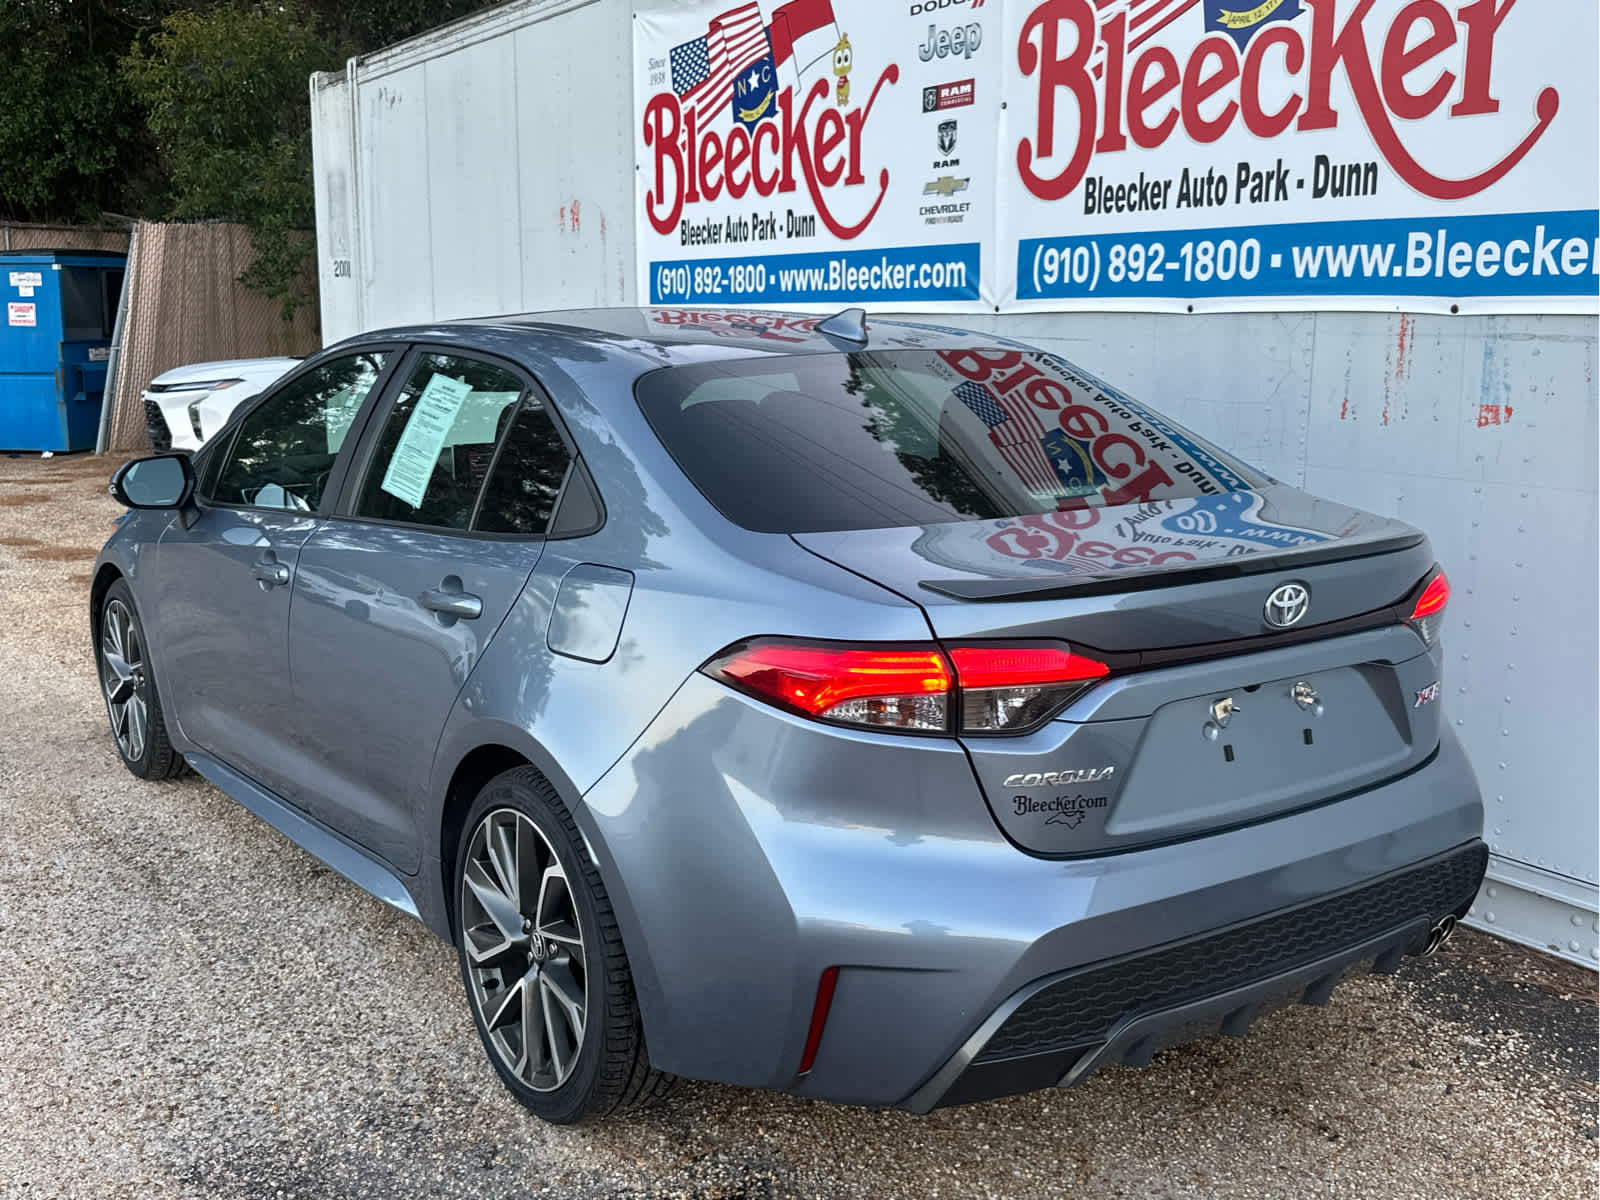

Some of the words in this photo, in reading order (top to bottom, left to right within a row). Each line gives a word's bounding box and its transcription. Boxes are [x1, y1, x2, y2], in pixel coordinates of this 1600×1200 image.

[910, 0, 970, 16] DOD
[919, 22, 982, 62] Jeep
[941, 84, 972, 98] RAM
[1017, 0, 1560, 201] Bleecker
[643, 64, 899, 240] Bleecker
[933, 158, 960, 169] RAM
[1083, 178, 1171, 215] Bleecker
[1176, 166, 1227, 209] Auto
[1235, 158, 1289, 202] Park
[1312, 154, 1378, 199] Dunn
[681, 219, 722, 246] Bleecker
[725, 215, 749, 244] Auto
[752, 211, 777, 241] Park
[787, 209, 816, 238] Dunn
[920, 202, 971, 216] CHEVROLET
[656, 265, 691, 301] (910)
[694, 265, 766, 296] 892-1800
[779, 257, 967, 291] www.Bleecker.com
[1032, 241, 1101, 291] (910)
[1107, 238, 1261, 282] 892-1800
[1003, 766, 1115, 788] COROLLA
